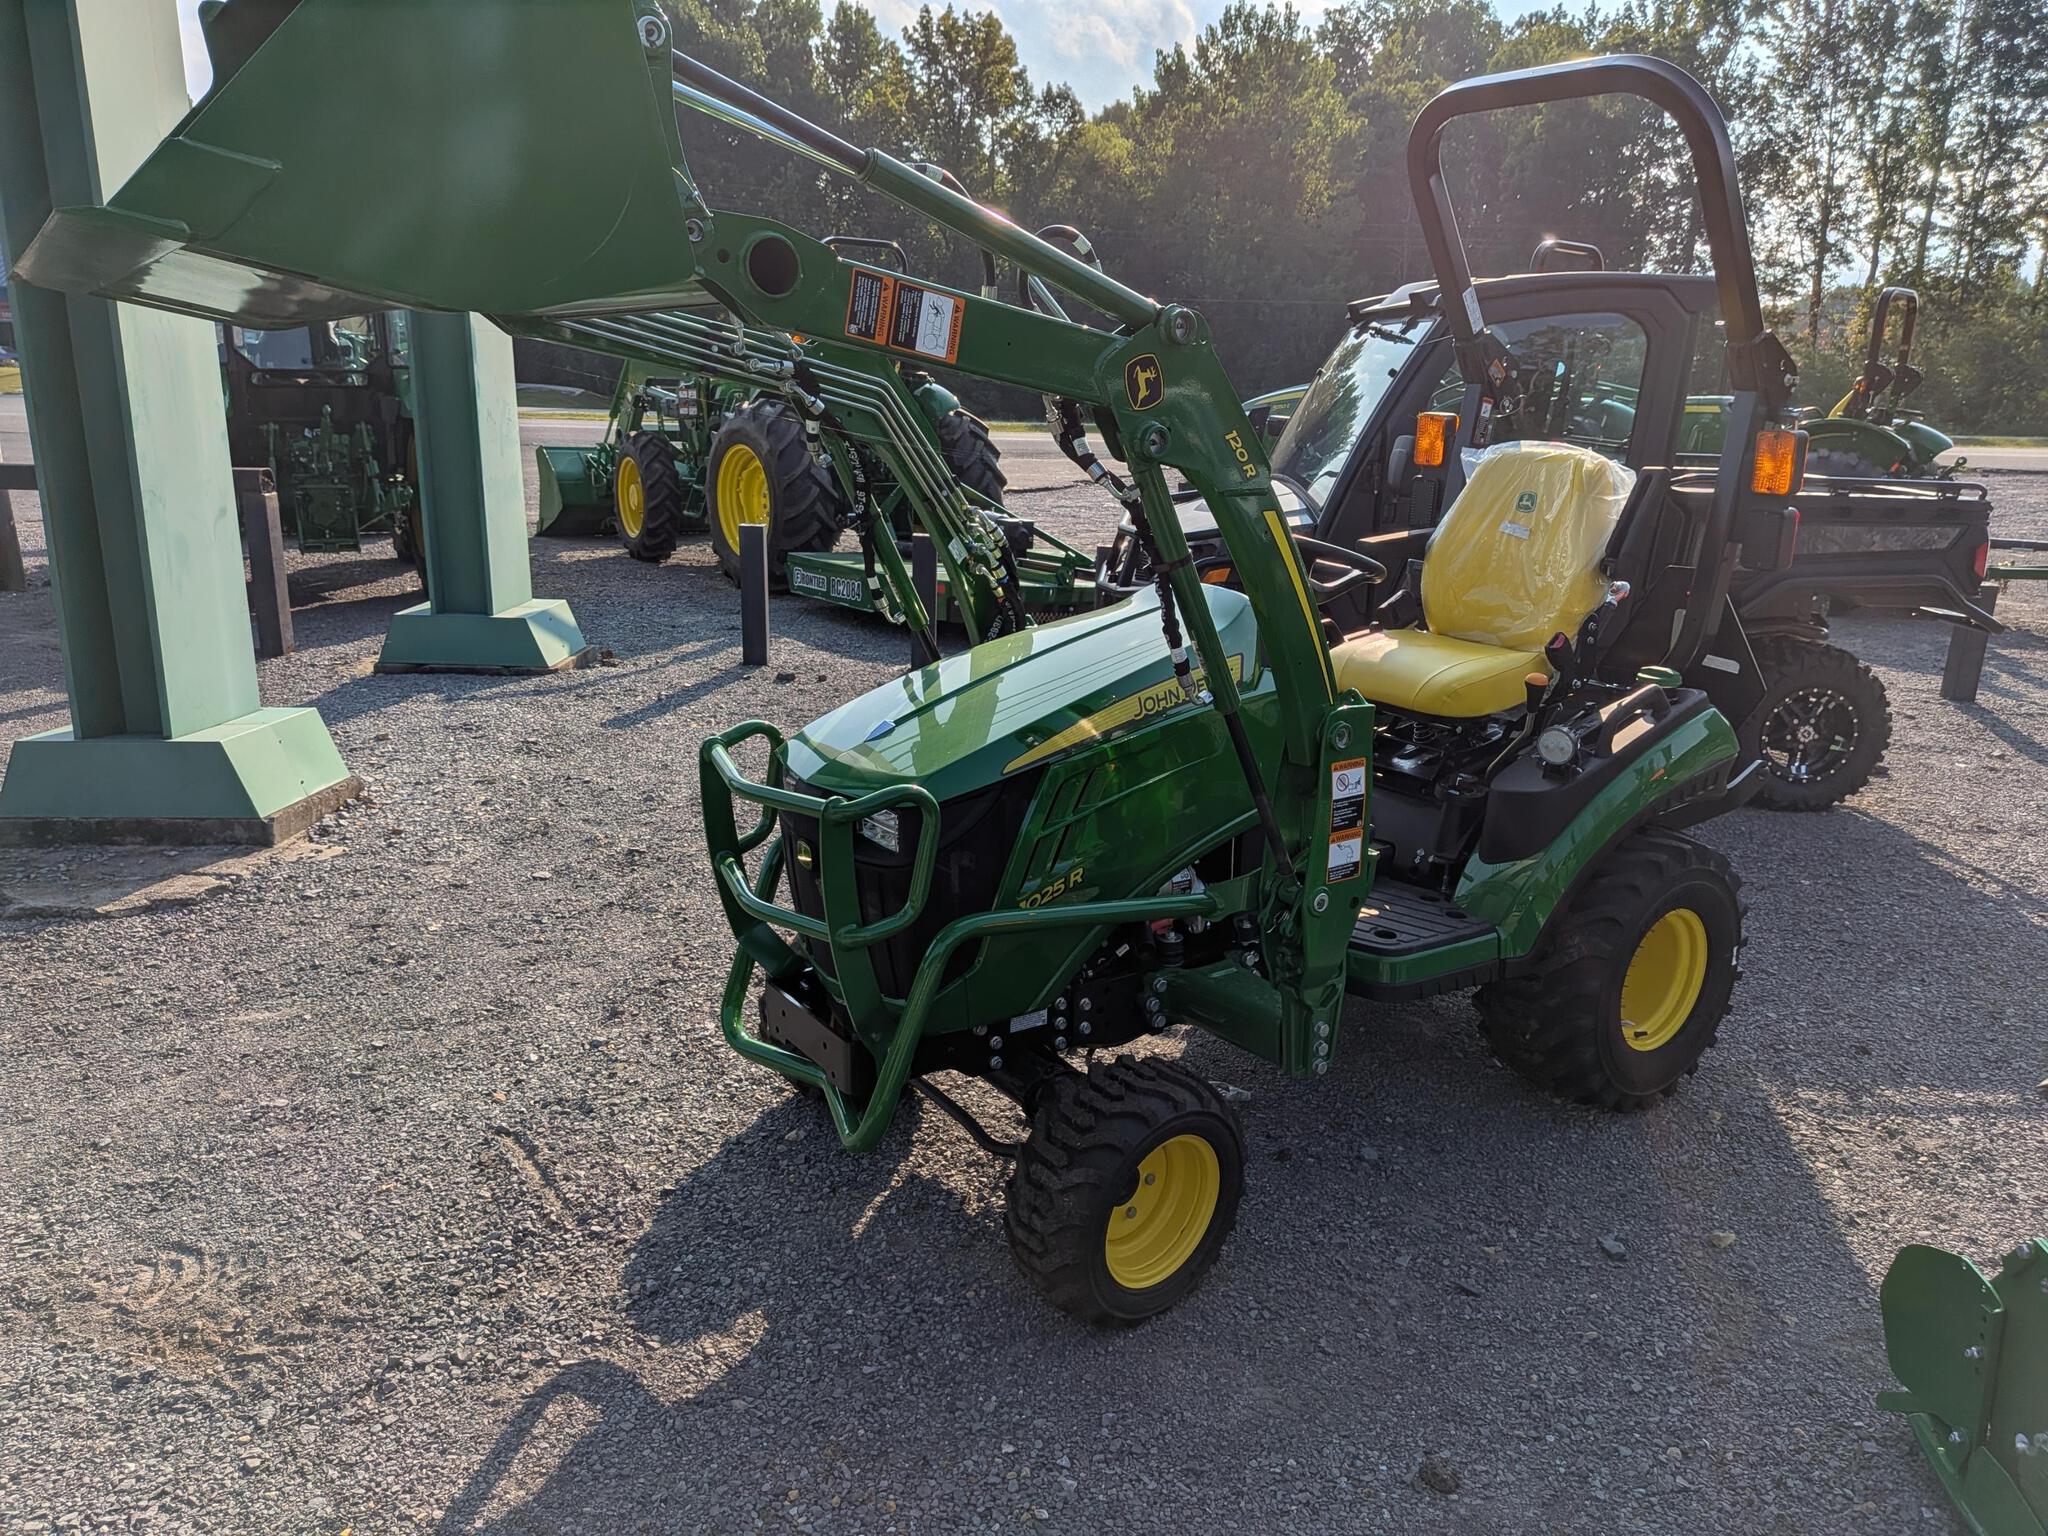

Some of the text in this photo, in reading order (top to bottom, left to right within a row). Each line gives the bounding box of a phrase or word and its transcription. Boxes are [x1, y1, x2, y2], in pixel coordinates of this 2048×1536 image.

[877, 293, 890, 337] WARNING
[949, 314, 961, 356] WARNING
[794, 568, 861, 601] FRONTIER RC2084
[1134, 686, 1181, 719] JOHN
[1340, 759, 1364, 771] WARNING
